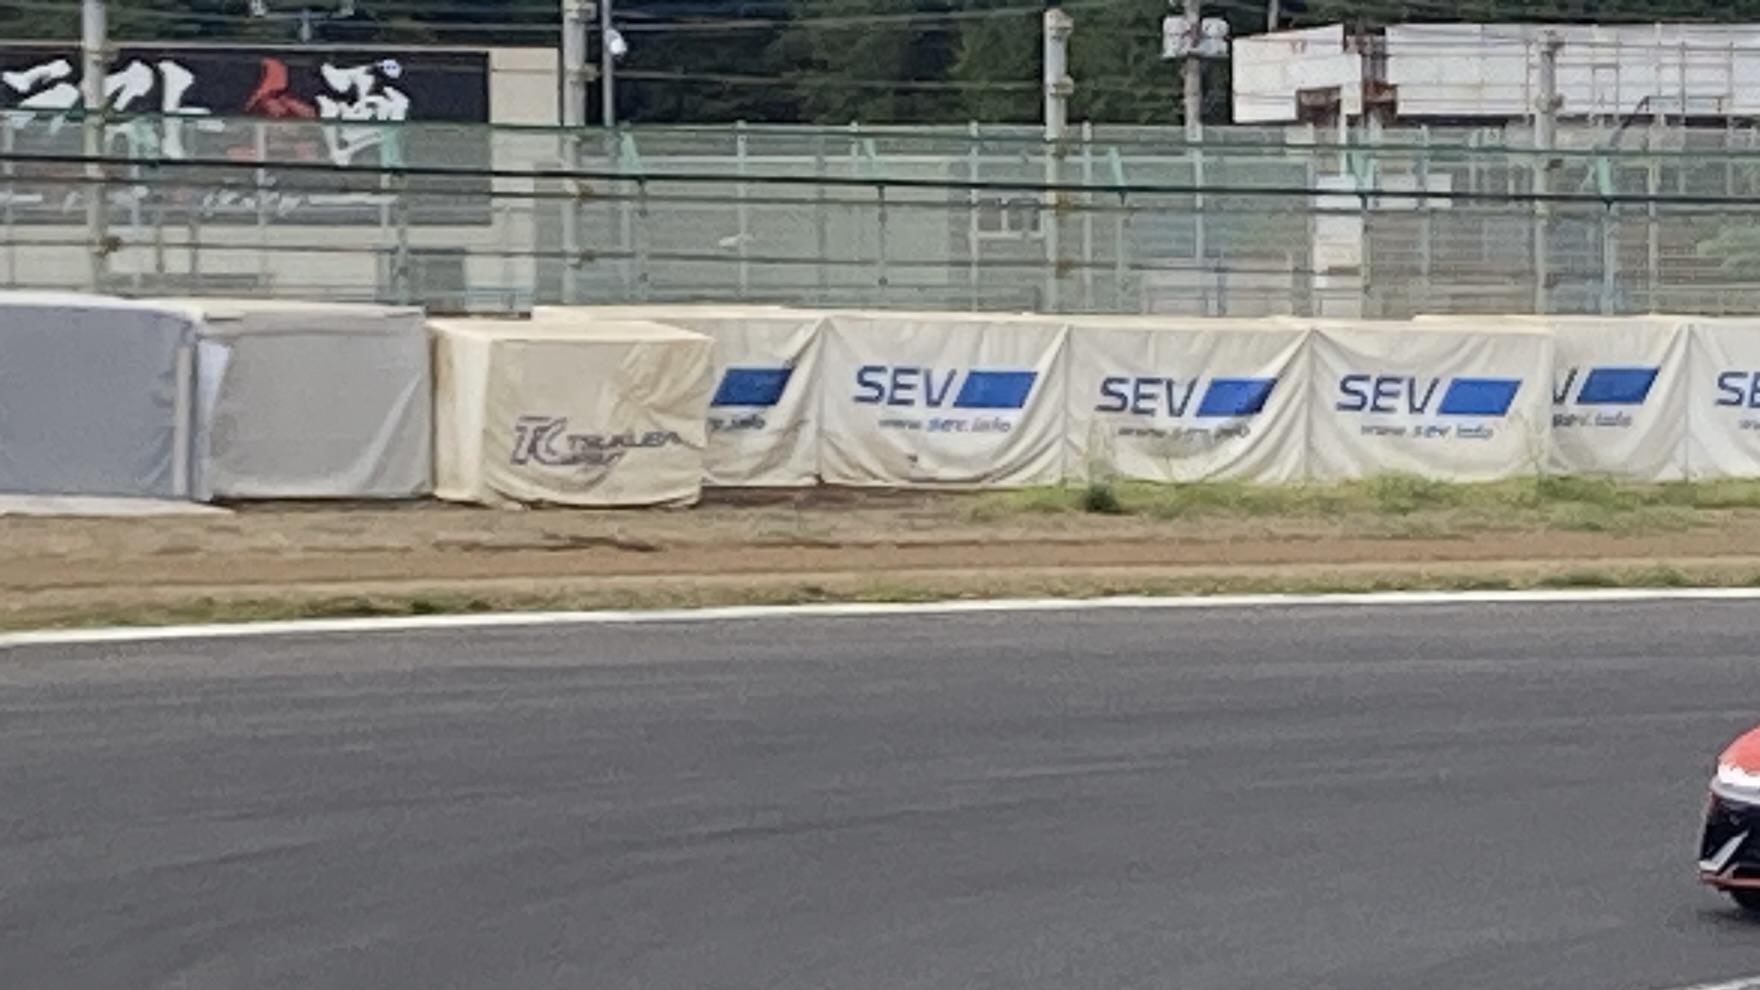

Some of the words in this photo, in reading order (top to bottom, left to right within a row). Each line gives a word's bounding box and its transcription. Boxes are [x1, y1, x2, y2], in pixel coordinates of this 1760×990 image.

[853, 366, 957, 407] SEV
[1094, 377, 1199, 417] SEV
[1336, 374, 1440, 414] SEV
